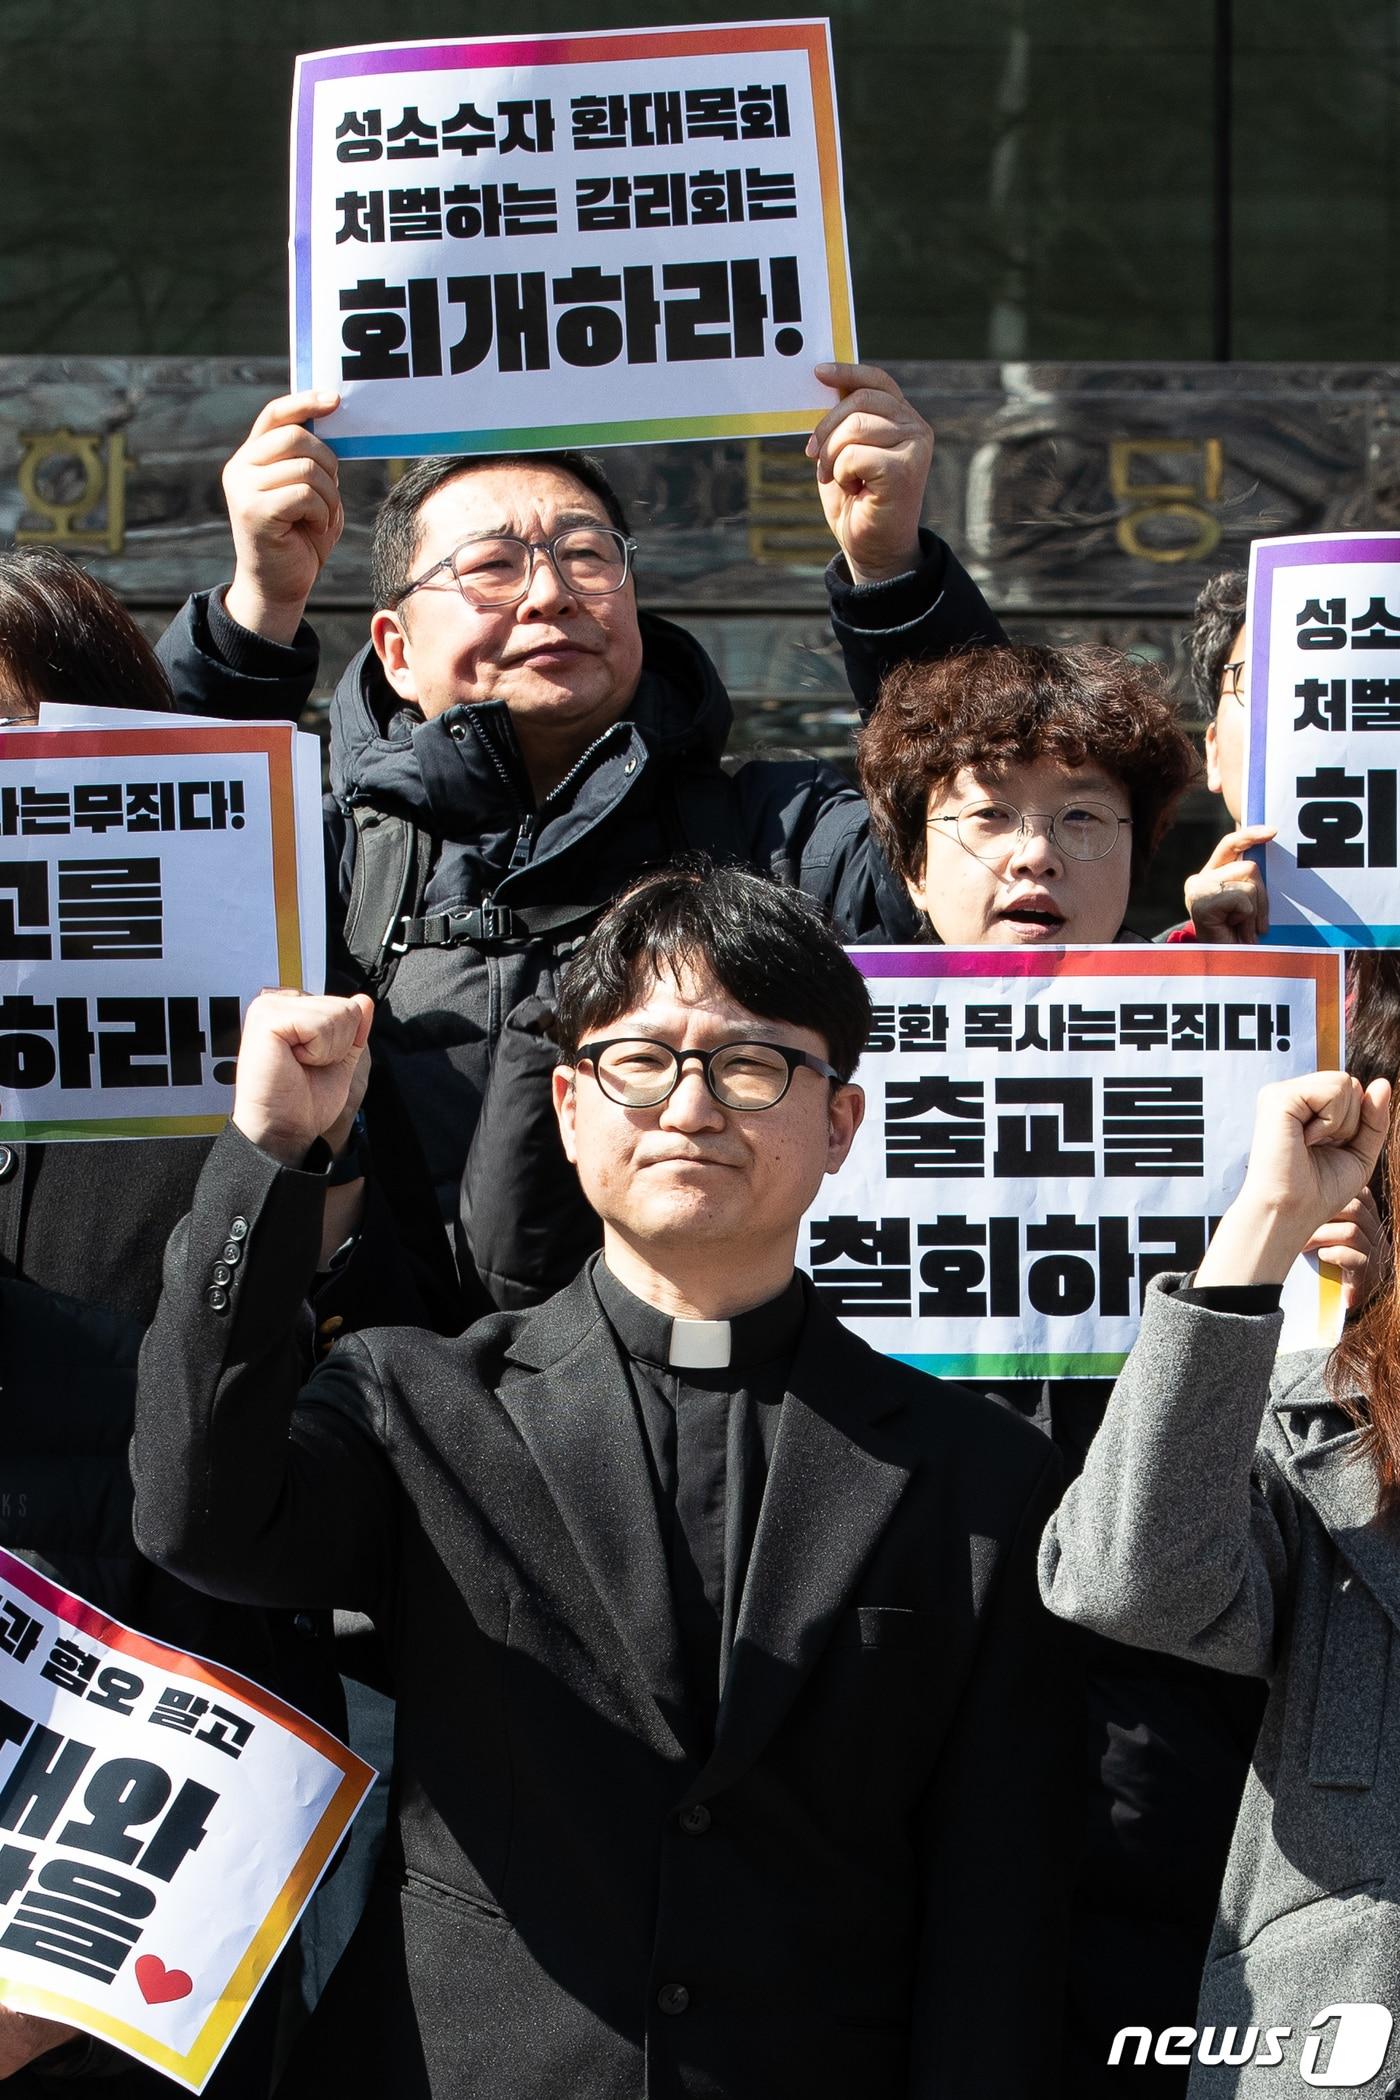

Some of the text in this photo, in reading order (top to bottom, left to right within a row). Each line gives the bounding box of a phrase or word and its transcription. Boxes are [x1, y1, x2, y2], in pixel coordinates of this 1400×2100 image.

[335, 84, 791, 163] 성소수자 환대목회
[335, 168, 797, 245] 처벌하는 감리회는
[339, 256, 804, 381] 회개하라!
[1296, 597, 1400, 650] 성소
[1294, 678, 1400, 731] 처벌
[1296, 767, 1397, 868] 회
[0, 995, 241, 1089] 하라!
[965, 1003, 1292, 1052] 목사는무죄다!
[884, 1076, 1205, 1178] 출교를
[40, 1637, 144, 1717] 혐오
[148, 1687, 255, 1760] 말고
[0, 1844, 156, 1985] 을
